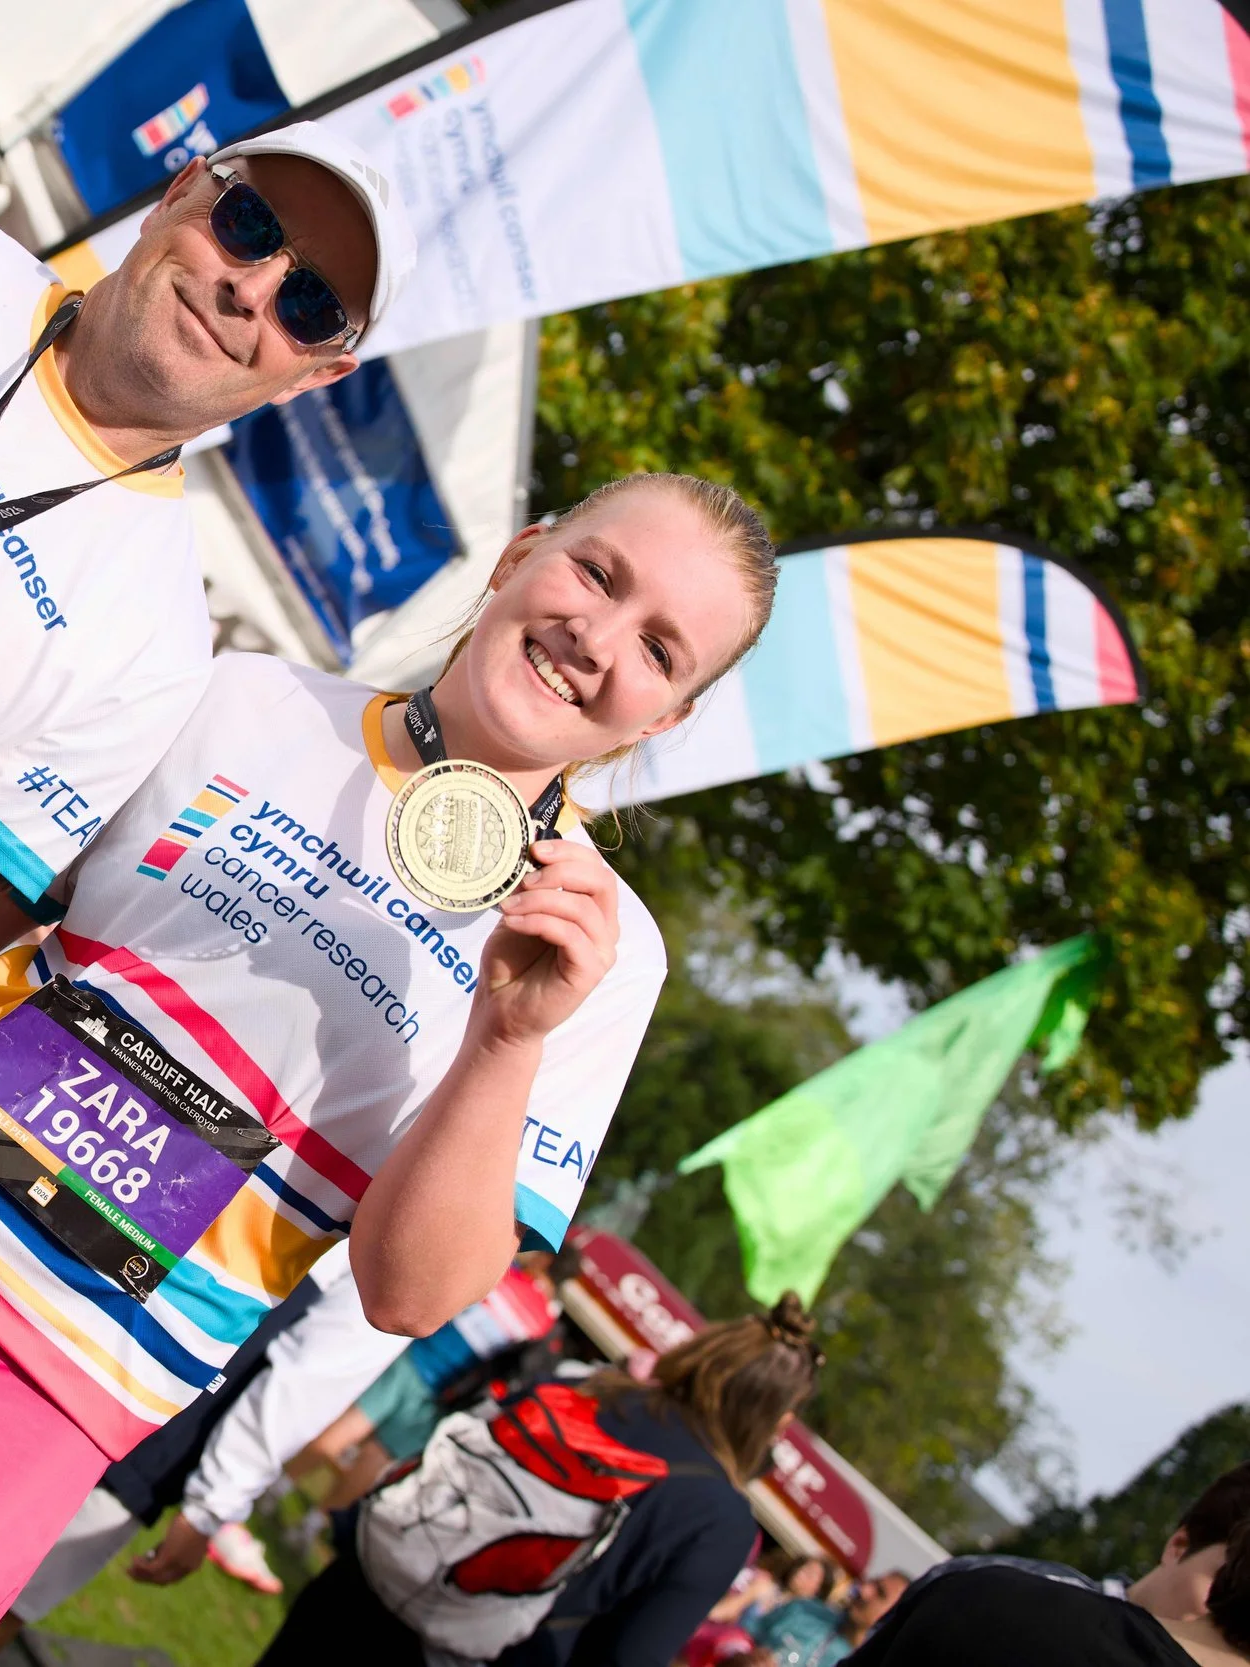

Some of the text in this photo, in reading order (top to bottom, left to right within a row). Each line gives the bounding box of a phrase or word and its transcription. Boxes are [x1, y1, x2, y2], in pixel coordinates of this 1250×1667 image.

[17, 766, 105, 849] #TEA
[230, 824, 329, 900] cymru
[250, 801, 391, 904] ymchwil
[180, 873, 268, 944] wales
[204, 846, 419, 1044] cancer research
[58, 1058, 171, 1165] ZARA
[111, 1046, 220, 1135] HANNER MARATHON CAERDYDD
[120, 1032, 232, 1122] CARDIFF HALF
[9, 1124, 29, 1144] PEN
[23, 1086, 151, 1204] 19668
[32, 1185, 50, 1201] 2026
[84, 1190, 156, 1251] FEMALE MEDIUM
